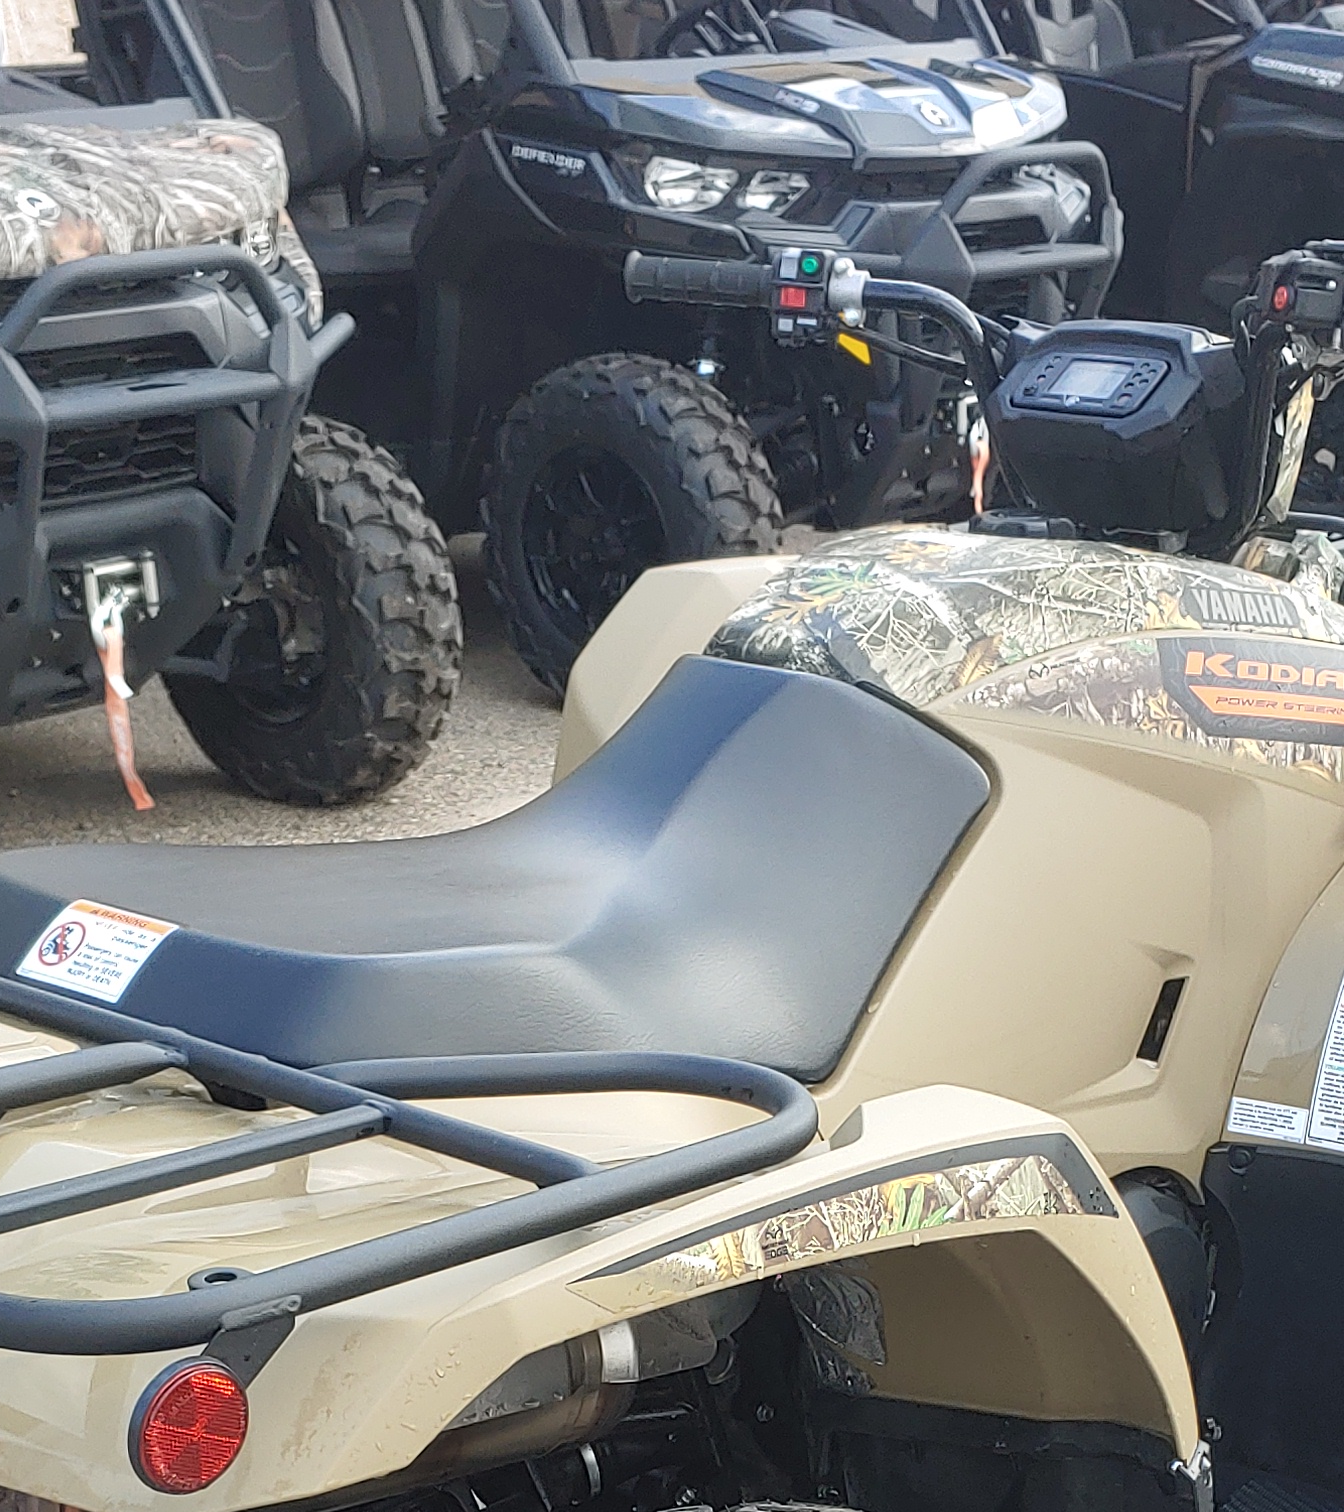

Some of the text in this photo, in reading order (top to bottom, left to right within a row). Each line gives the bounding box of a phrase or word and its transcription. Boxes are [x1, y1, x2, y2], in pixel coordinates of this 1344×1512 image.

[1190, 588, 1293, 626] YAMAHA
[1215, 695, 1278, 710] POWER
[99, 909, 149, 929] WARNING
